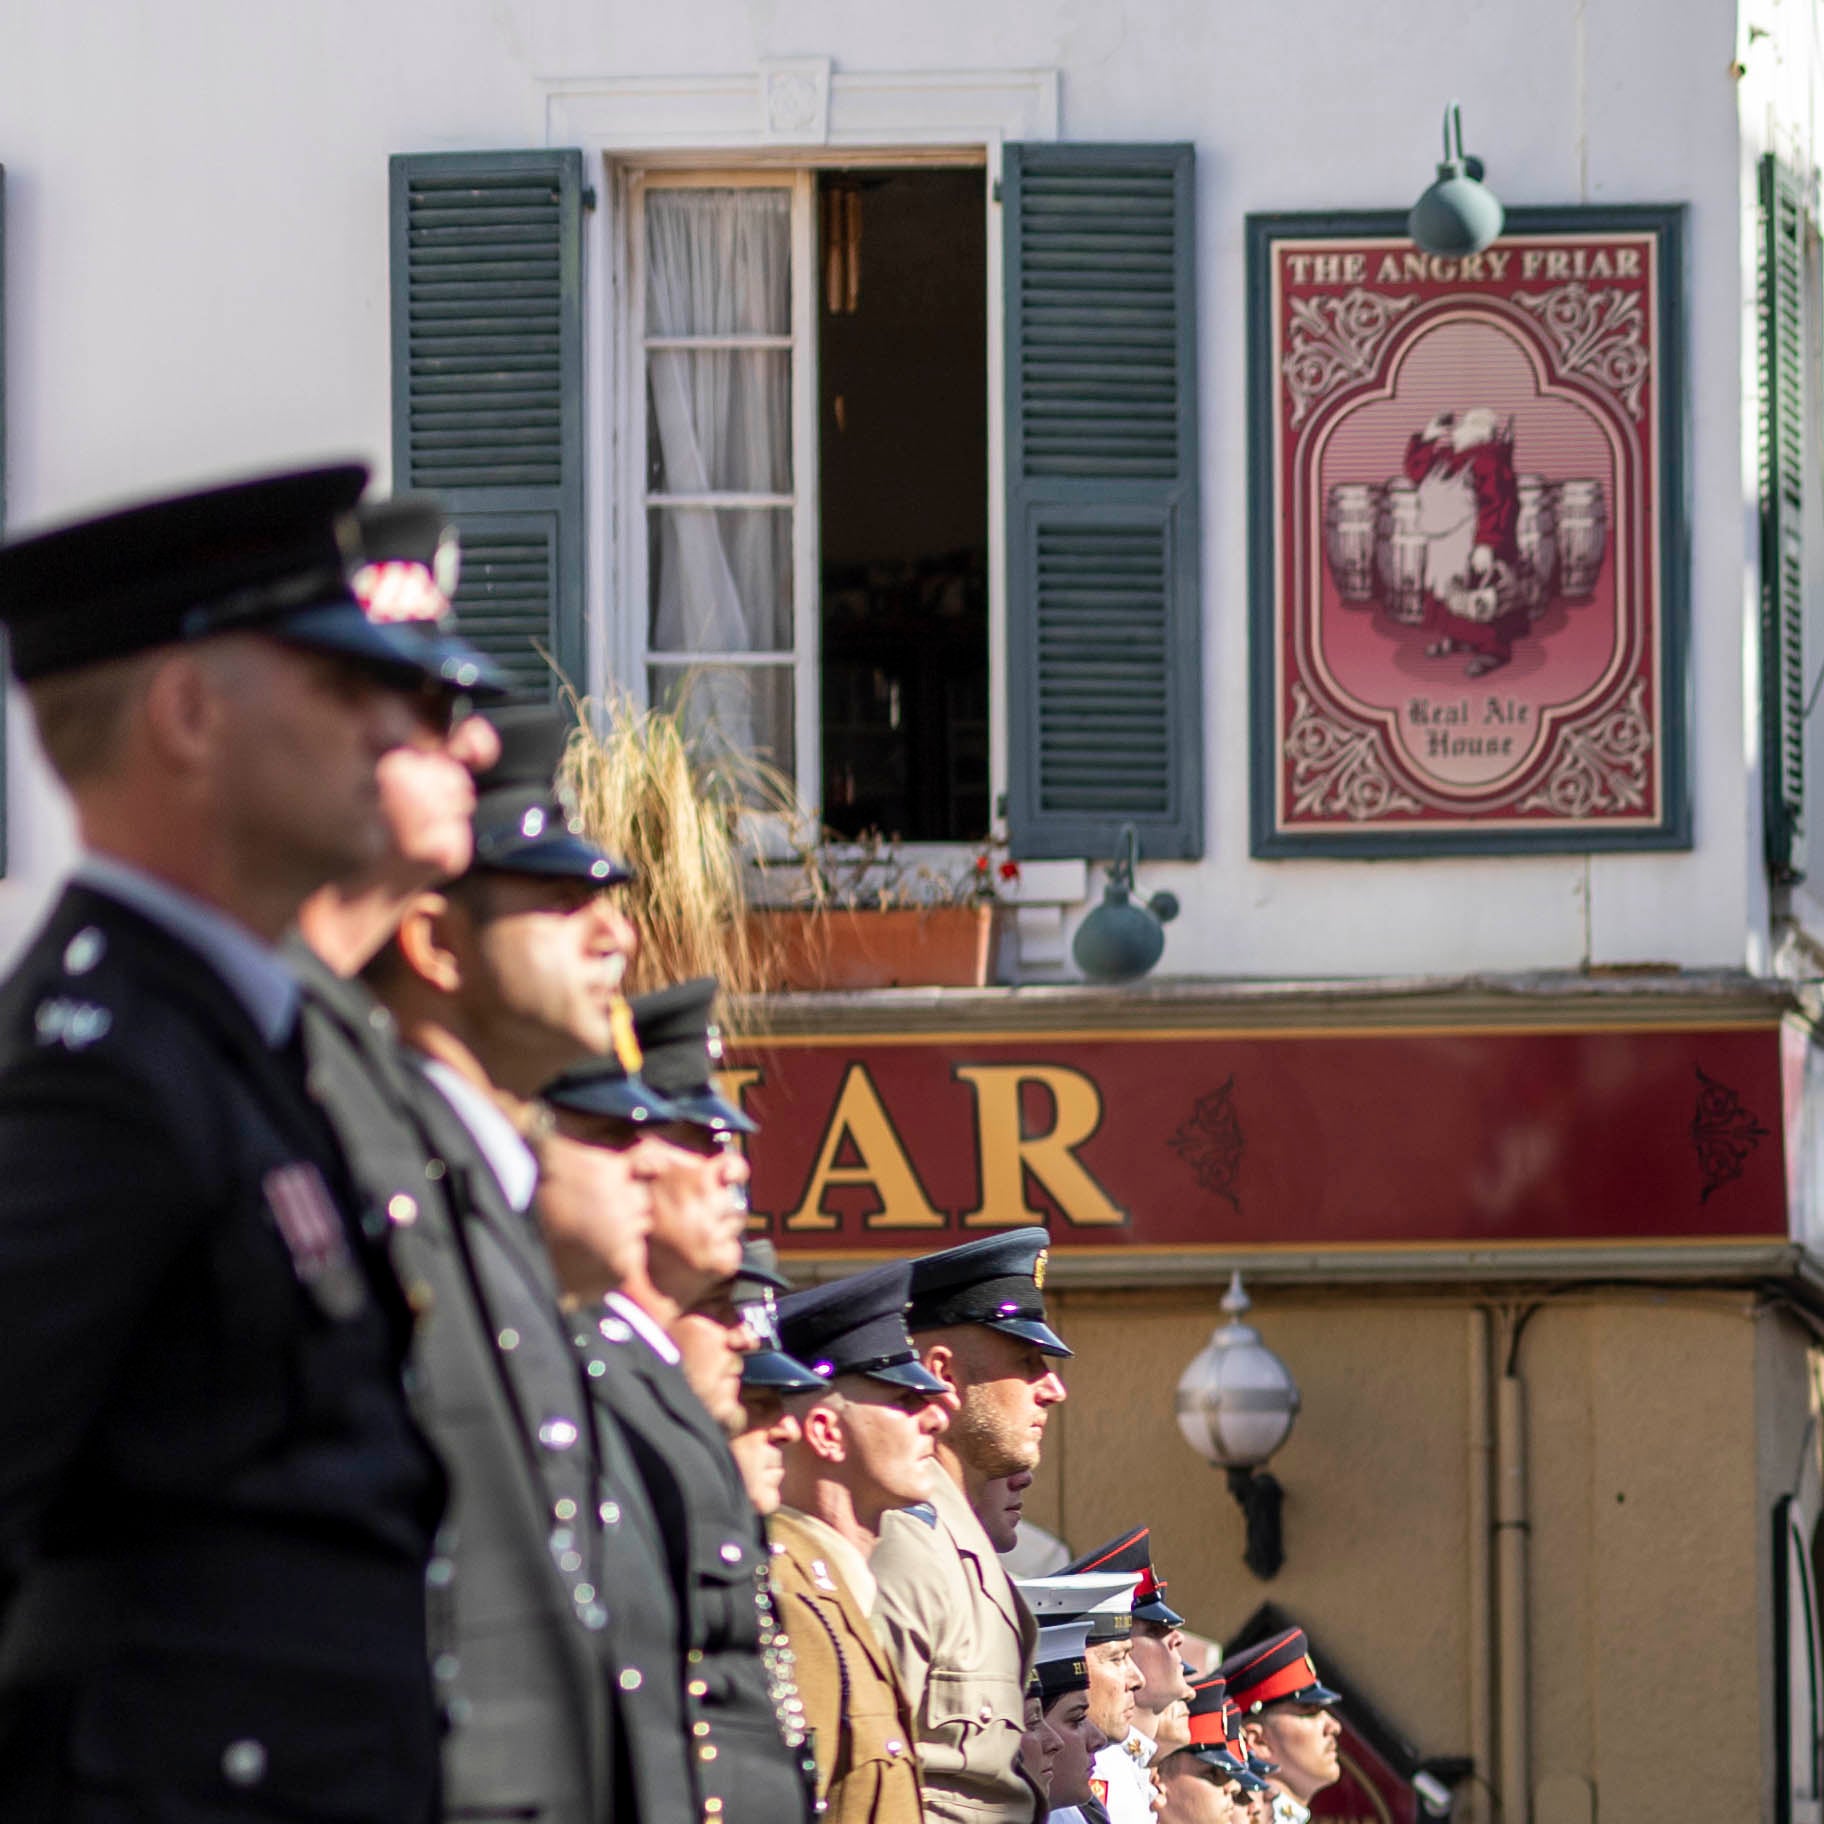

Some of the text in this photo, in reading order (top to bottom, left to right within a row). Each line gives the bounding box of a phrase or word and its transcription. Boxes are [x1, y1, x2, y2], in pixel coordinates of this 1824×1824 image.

[1287, 249, 1642, 285] THE ANGRY FRIAR
[1408, 696, 1529, 725] Real Ale
[1427, 728, 1513, 758] House
